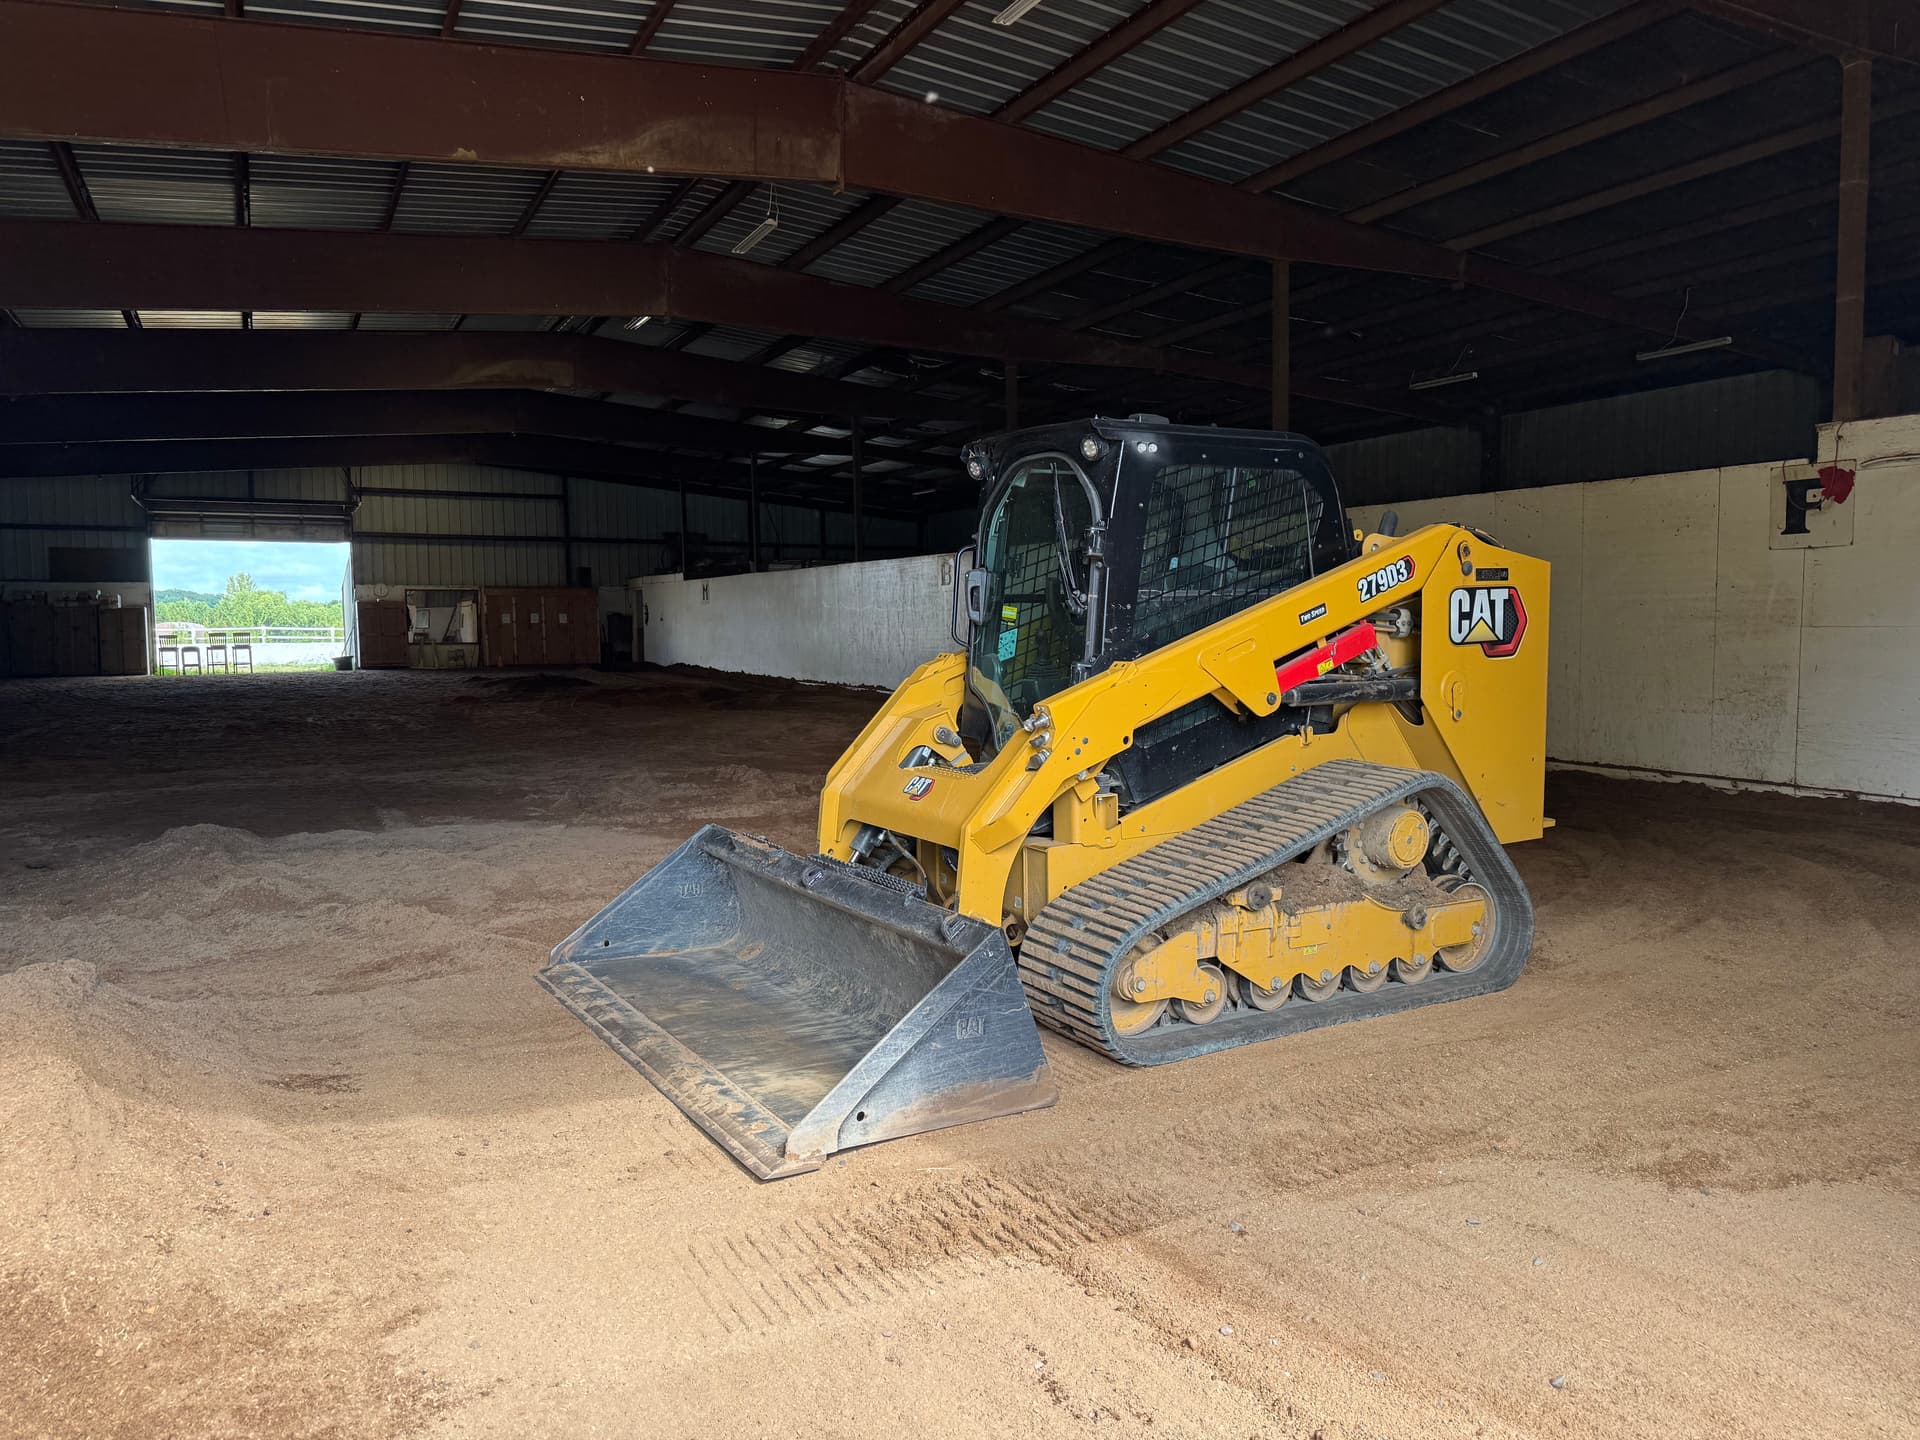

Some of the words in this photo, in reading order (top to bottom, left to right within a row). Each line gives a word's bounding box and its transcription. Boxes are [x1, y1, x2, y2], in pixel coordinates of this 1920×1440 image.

[1781, 478, 1826, 535] F
[1357, 559, 1408, 602] 279D3
[1450, 588, 1509, 643] CAT
[904, 776, 933, 796] CAT
[956, 1016, 985, 1040] CAT
